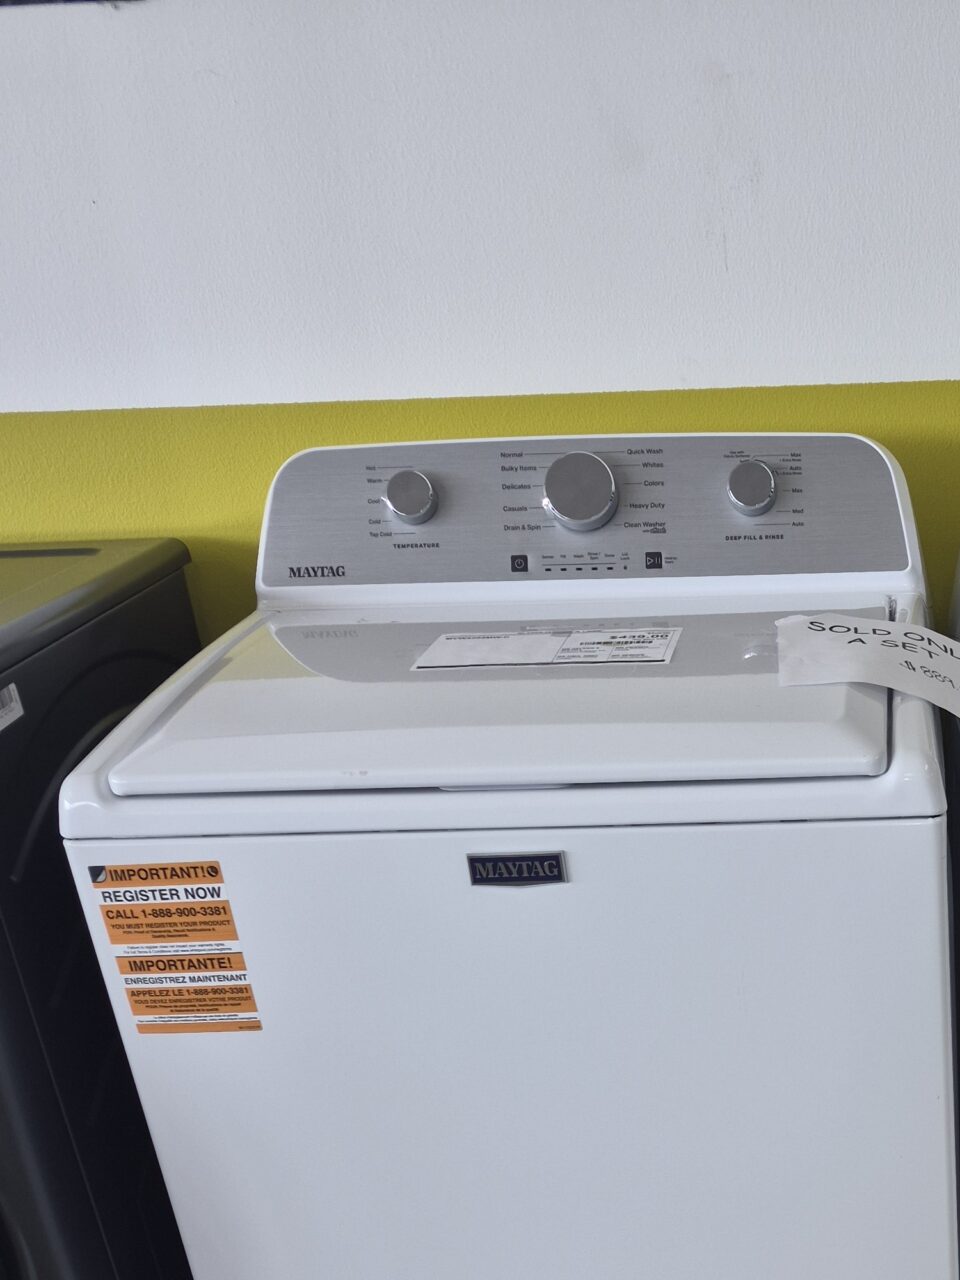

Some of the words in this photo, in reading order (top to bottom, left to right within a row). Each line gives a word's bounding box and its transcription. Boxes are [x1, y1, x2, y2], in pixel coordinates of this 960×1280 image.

[288, 565, 346, 578] MAYTAG
[807, 621, 891, 637] SOLD
[848, 637, 868, 645] A
[880, 639, 940, 659] SET
[109, 865, 206, 882] IMPORTANT!
[473, 860, 558, 878] MAYTAG
[101, 889, 180, 903] REGISTER
[184, 886, 222, 900] NOW
[106, 910, 139, 920] CALL
[141, 906, 228, 918] 1-888-900-3381
[128, 957, 232, 972] IMPORTANTE!
[124, 976, 187, 985] ENREGISTREZ
[189, 974, 247, 983] MAINTENANT
[130, 988, 171, 997] APPELEZ
[173, 988, 184, 996] LE
[186, 986, 249, 996] 1-888-900-3381
